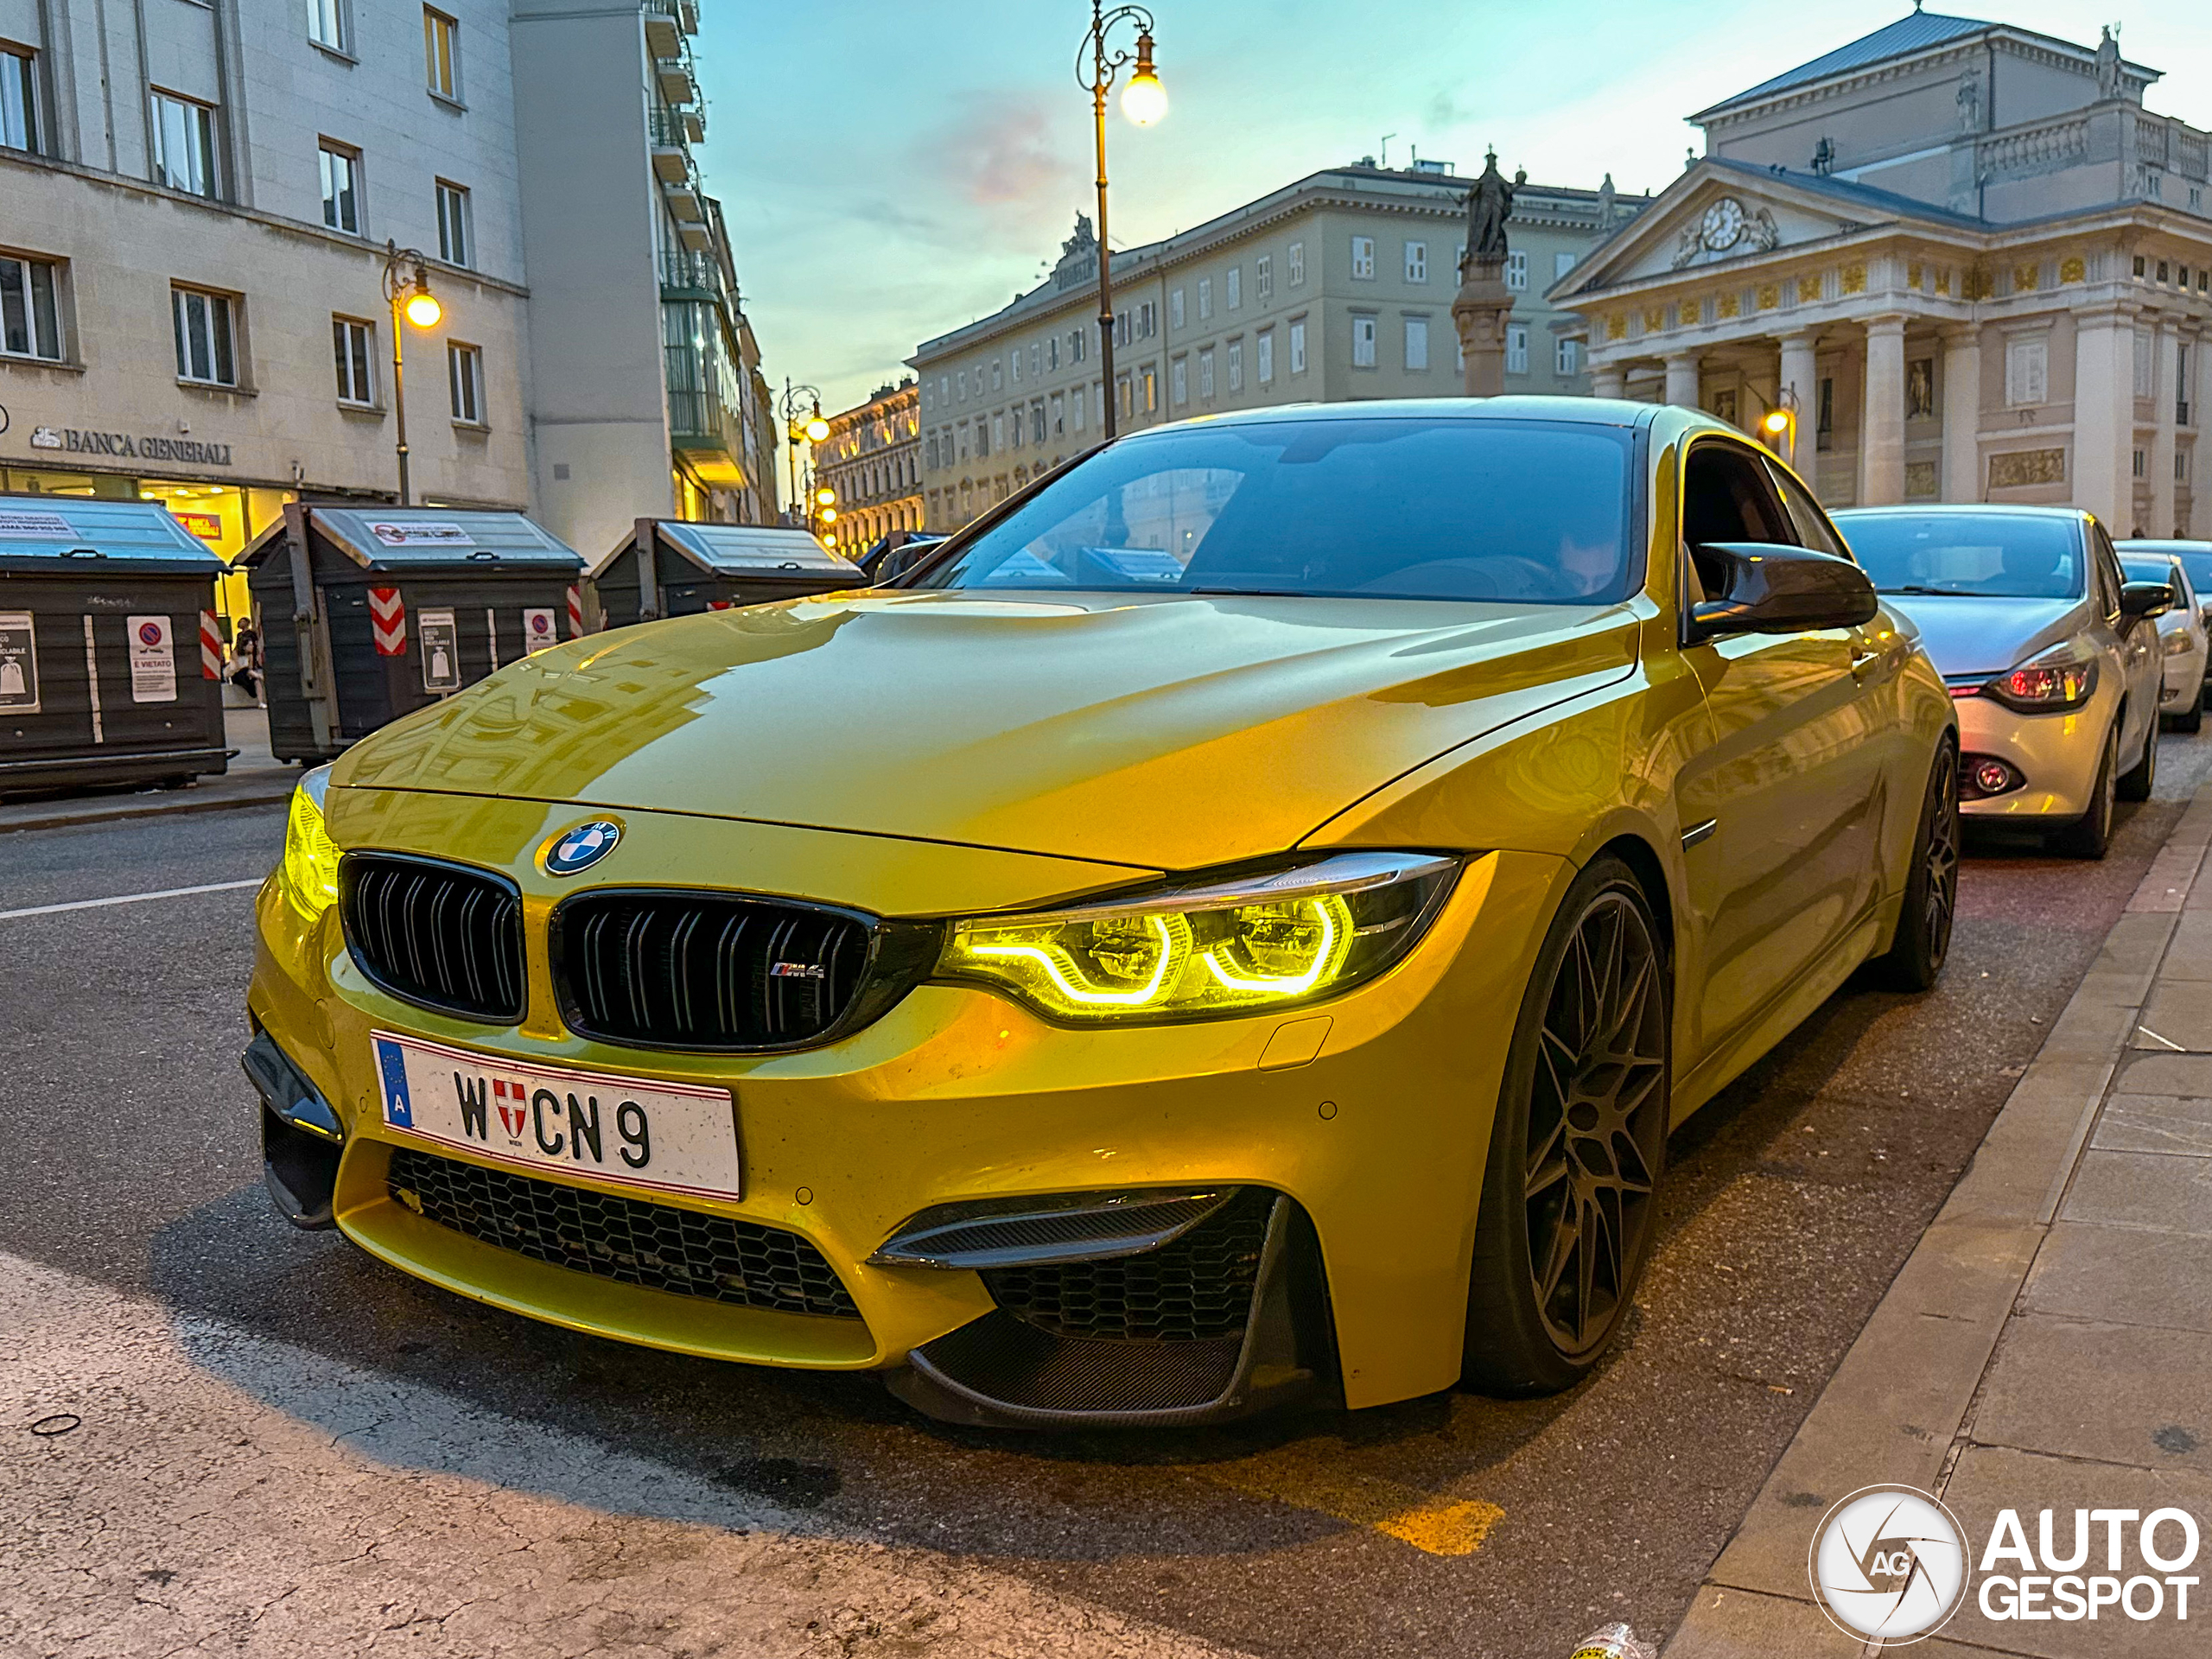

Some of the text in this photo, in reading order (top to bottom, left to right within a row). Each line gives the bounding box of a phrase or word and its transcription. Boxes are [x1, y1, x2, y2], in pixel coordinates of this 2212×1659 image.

[64, 429, 232, 466] BANCA GENERALI
[394, 1094, 406, 1114] A
[454, 1071, 486, 1141] W
[616, 1100, 651, 1169] 9
